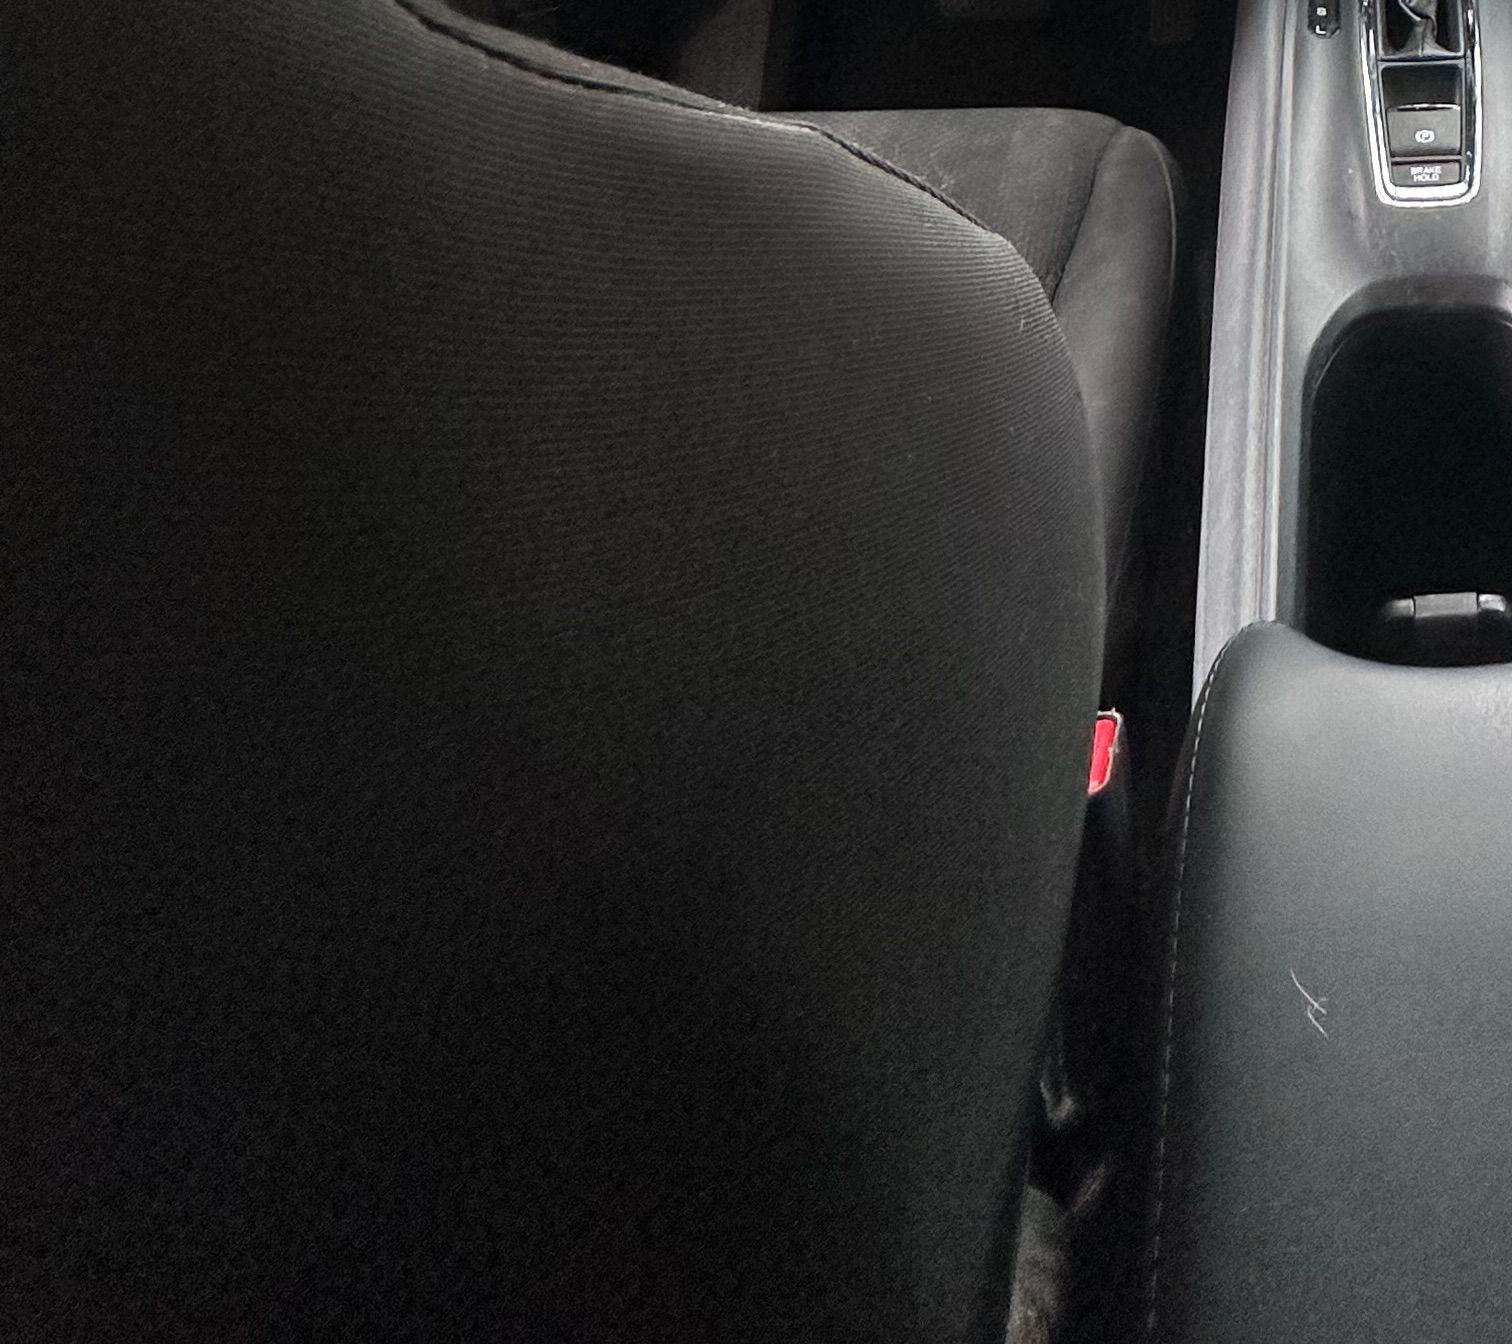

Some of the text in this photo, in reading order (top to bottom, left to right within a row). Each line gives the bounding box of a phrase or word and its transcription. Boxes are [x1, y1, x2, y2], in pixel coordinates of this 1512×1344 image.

[1315, 25, 1326, 35] L
[1410, 165, 1442, 176] BRAKE
[1413, 173, 1440, 182] HOLD
